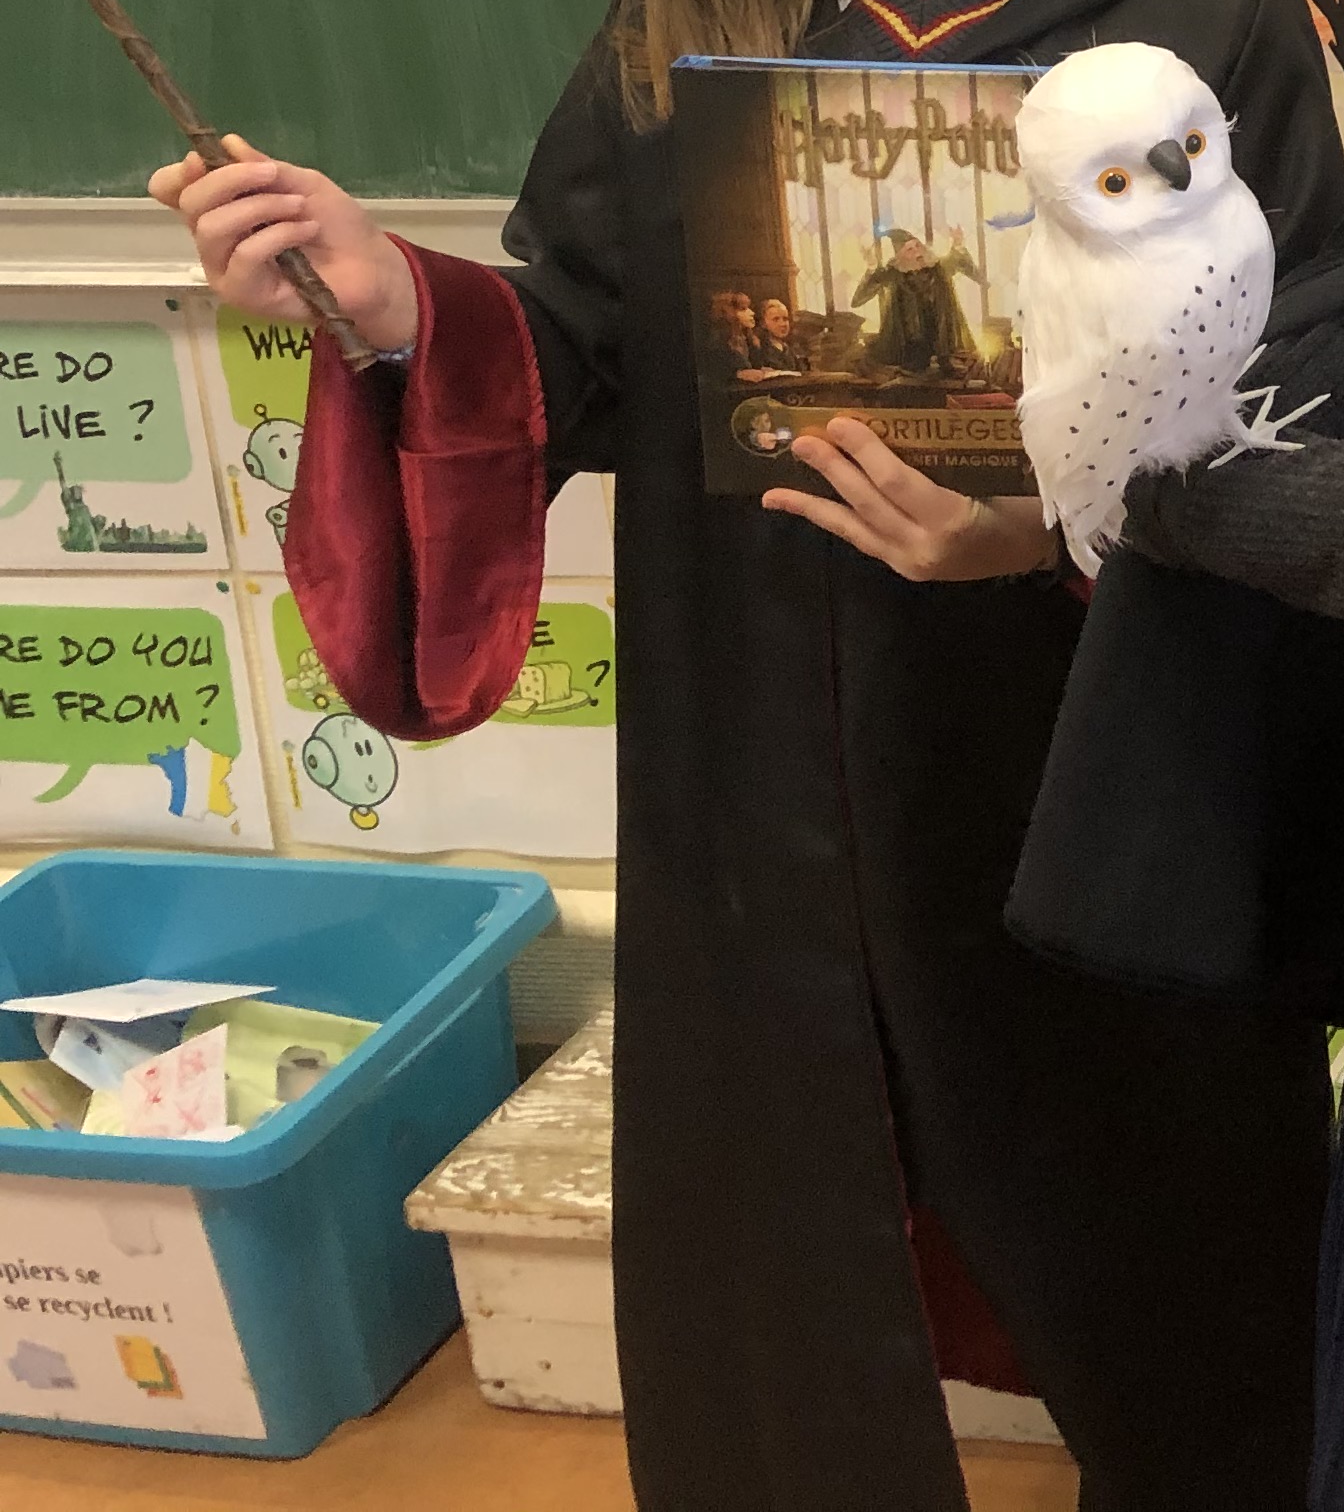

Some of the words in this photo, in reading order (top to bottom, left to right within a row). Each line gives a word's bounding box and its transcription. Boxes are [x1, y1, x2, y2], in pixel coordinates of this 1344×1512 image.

[55, 351, 113, 384] DO
[945, 455, 1018, 467] MAGIQUE
[59, 635, 116, 667] DO
[132, 632, 212, 668] YOU
[52, 691, 180, 724] FROM
[75, 1267, 101, 1285] se
[3, 1295, 31, 1312] se
[38, 1296, 158, 1323] recyclent
